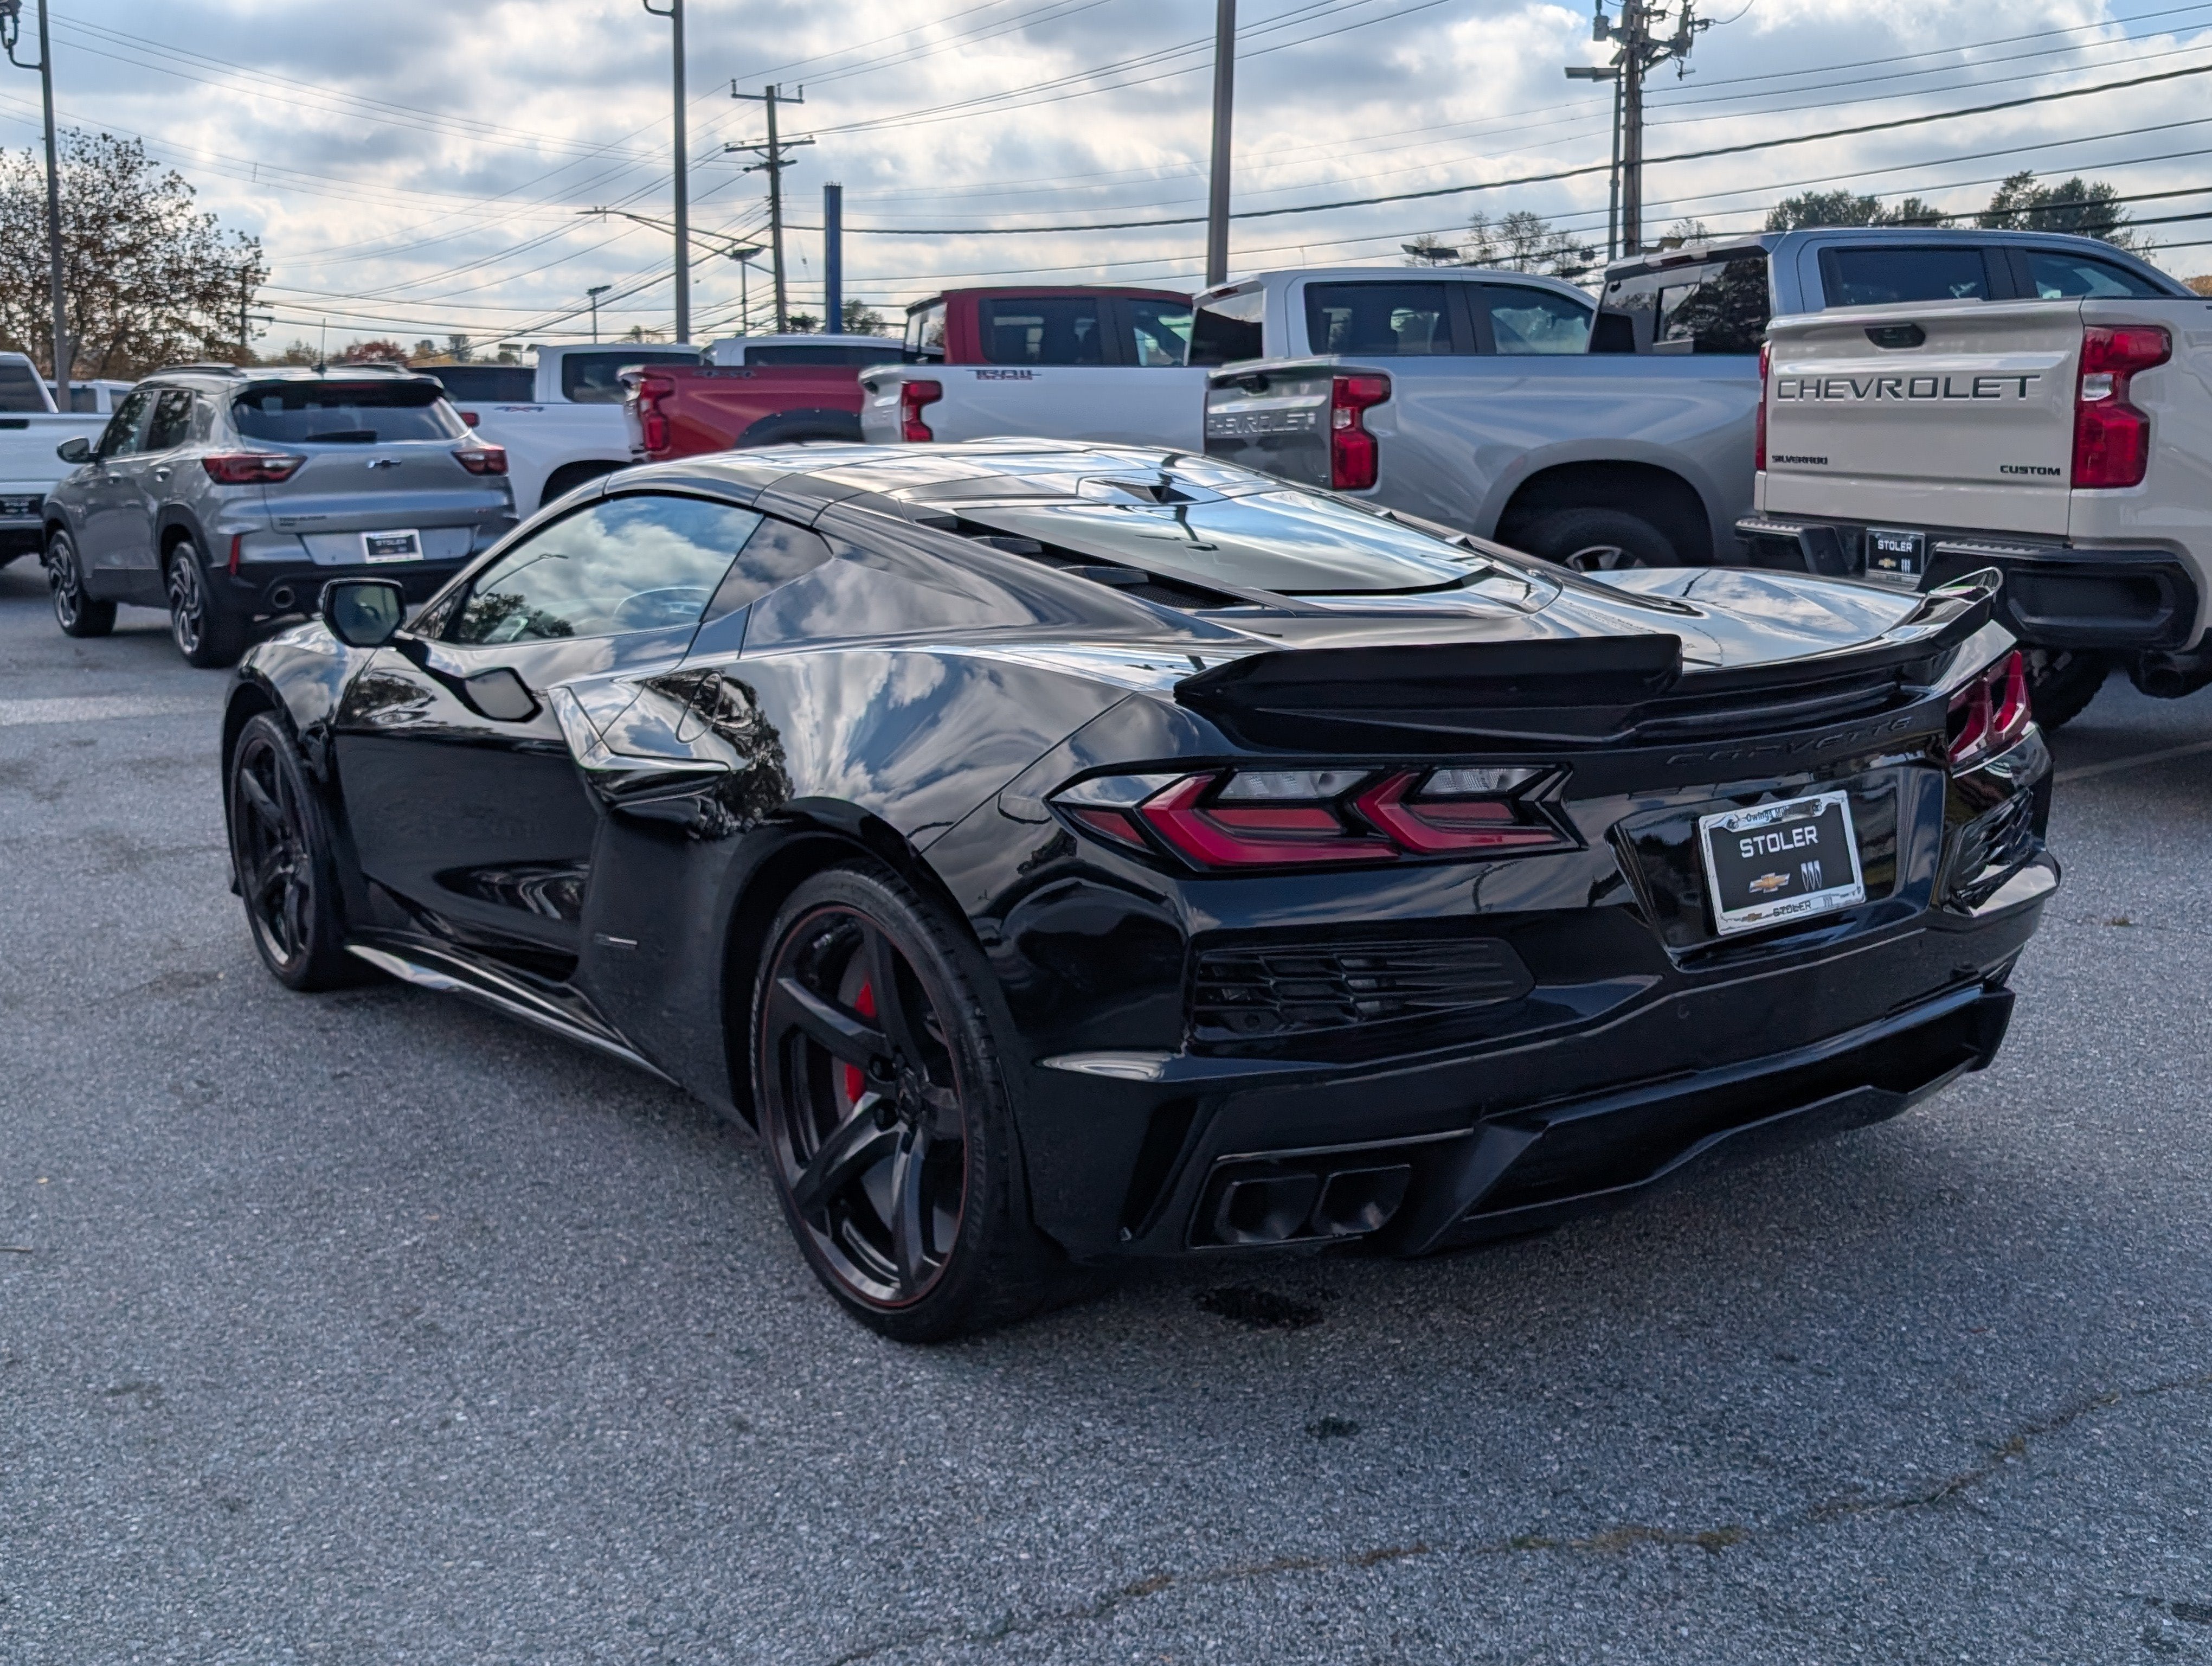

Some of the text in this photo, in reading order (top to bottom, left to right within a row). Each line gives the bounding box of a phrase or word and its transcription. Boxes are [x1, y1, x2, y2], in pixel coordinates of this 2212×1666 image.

[1777, 375, 2041, 401] CHEVROLET
[2000, 465, 2060, 476] CUSTOM
[1877, 539, 1912, 553] STOLER
[1746, 810, 1773, 822] Owings
[1739, 825, 1819, 858] STOLER
[1772, 900, 1812, 917] STOLER
